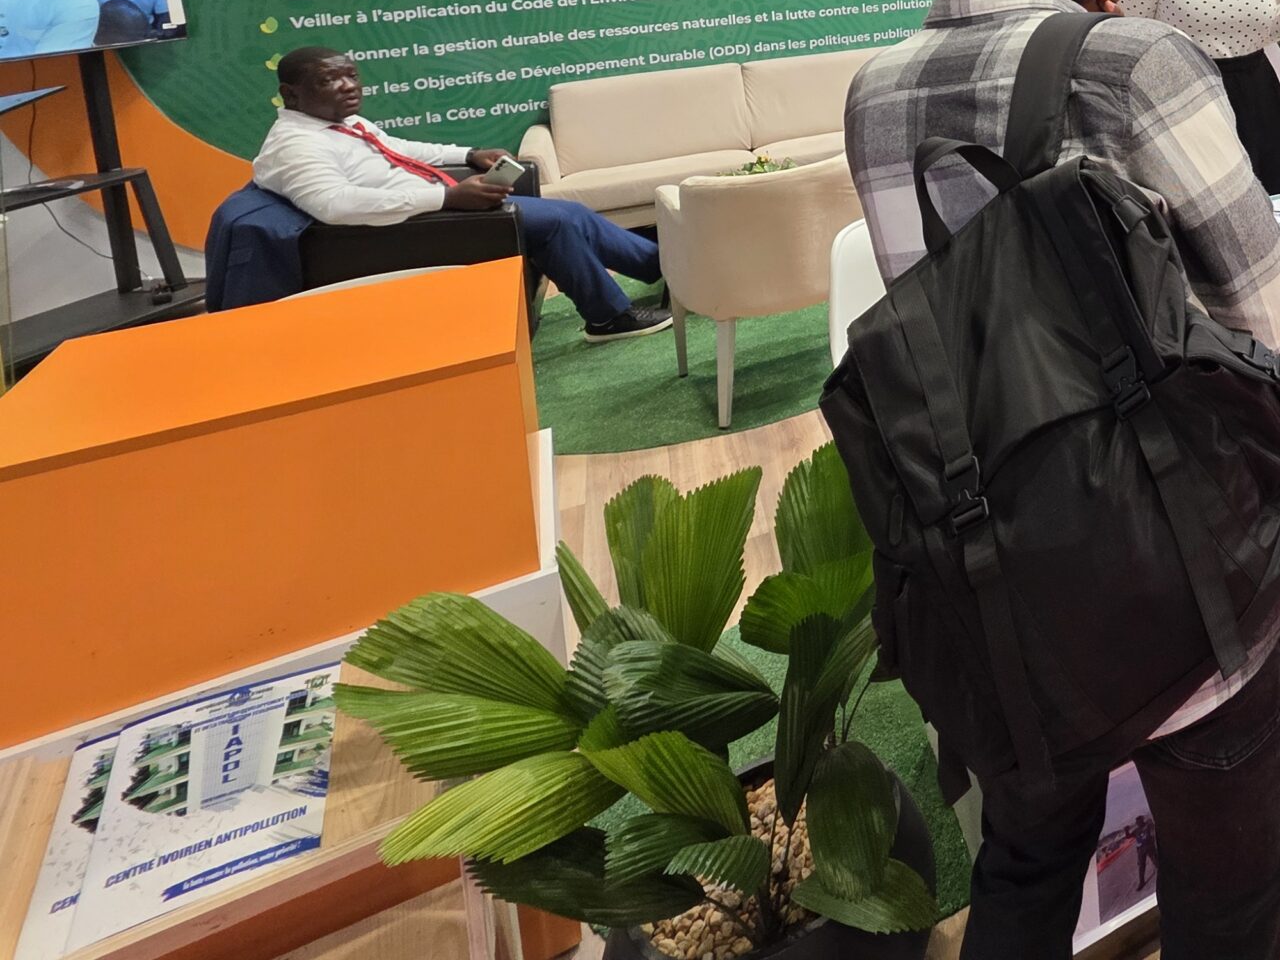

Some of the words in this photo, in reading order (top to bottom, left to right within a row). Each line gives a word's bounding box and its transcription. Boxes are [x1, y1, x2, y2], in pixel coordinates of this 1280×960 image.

[289, 13, 351, 29] Veiller
[356, 10, 368, 23] à
[372, 3, 482, 24] l'application
[485, 0, 508, 14] du
[345, 46, 409, 62] onner
[413, 43, 430, 56] la
[434, 36, 498, 57] gestion
[501, 32, 564, 48] durable
[567, 28, 596, 41] des
[599, 20, 679, 38] ressources
[682, 13, 752, 30] naturelles
[754, 12, 769, 23] et
[771, 10, 783, 22] la
[786, 8, 816, 21] lutte
[819, 4, 859, 17] contre
[862, 3, 879, 13] les
[362, 84, 379, 97] er
[384, 80, 410, 95] les
[413, 71, 493, 91] Objectifs
[495, 68, 517, 82] de
[520, 54, 646, 79] Développement
[649, 48, 706, 65] Durable
[709, 43, 751, 60] (ODD)
[754, 41, 786, 54] dans
[788, 38, 807, 51] les
[809, 30, 871, 49] politiques
[873, 27, 923, 42] publiqu
[376, 113, 422, 131] enter
[426, 110, 442, 124] la
[446, 105, 486, 122] Côte
[490, 98, 549, 116] d'Ivoire
[104, 857, 156, 888] CENTRE
[156, 838, 213, 868] IVOIRIEN
[213, 805, 308, 847] ANTIPOLLUTION
